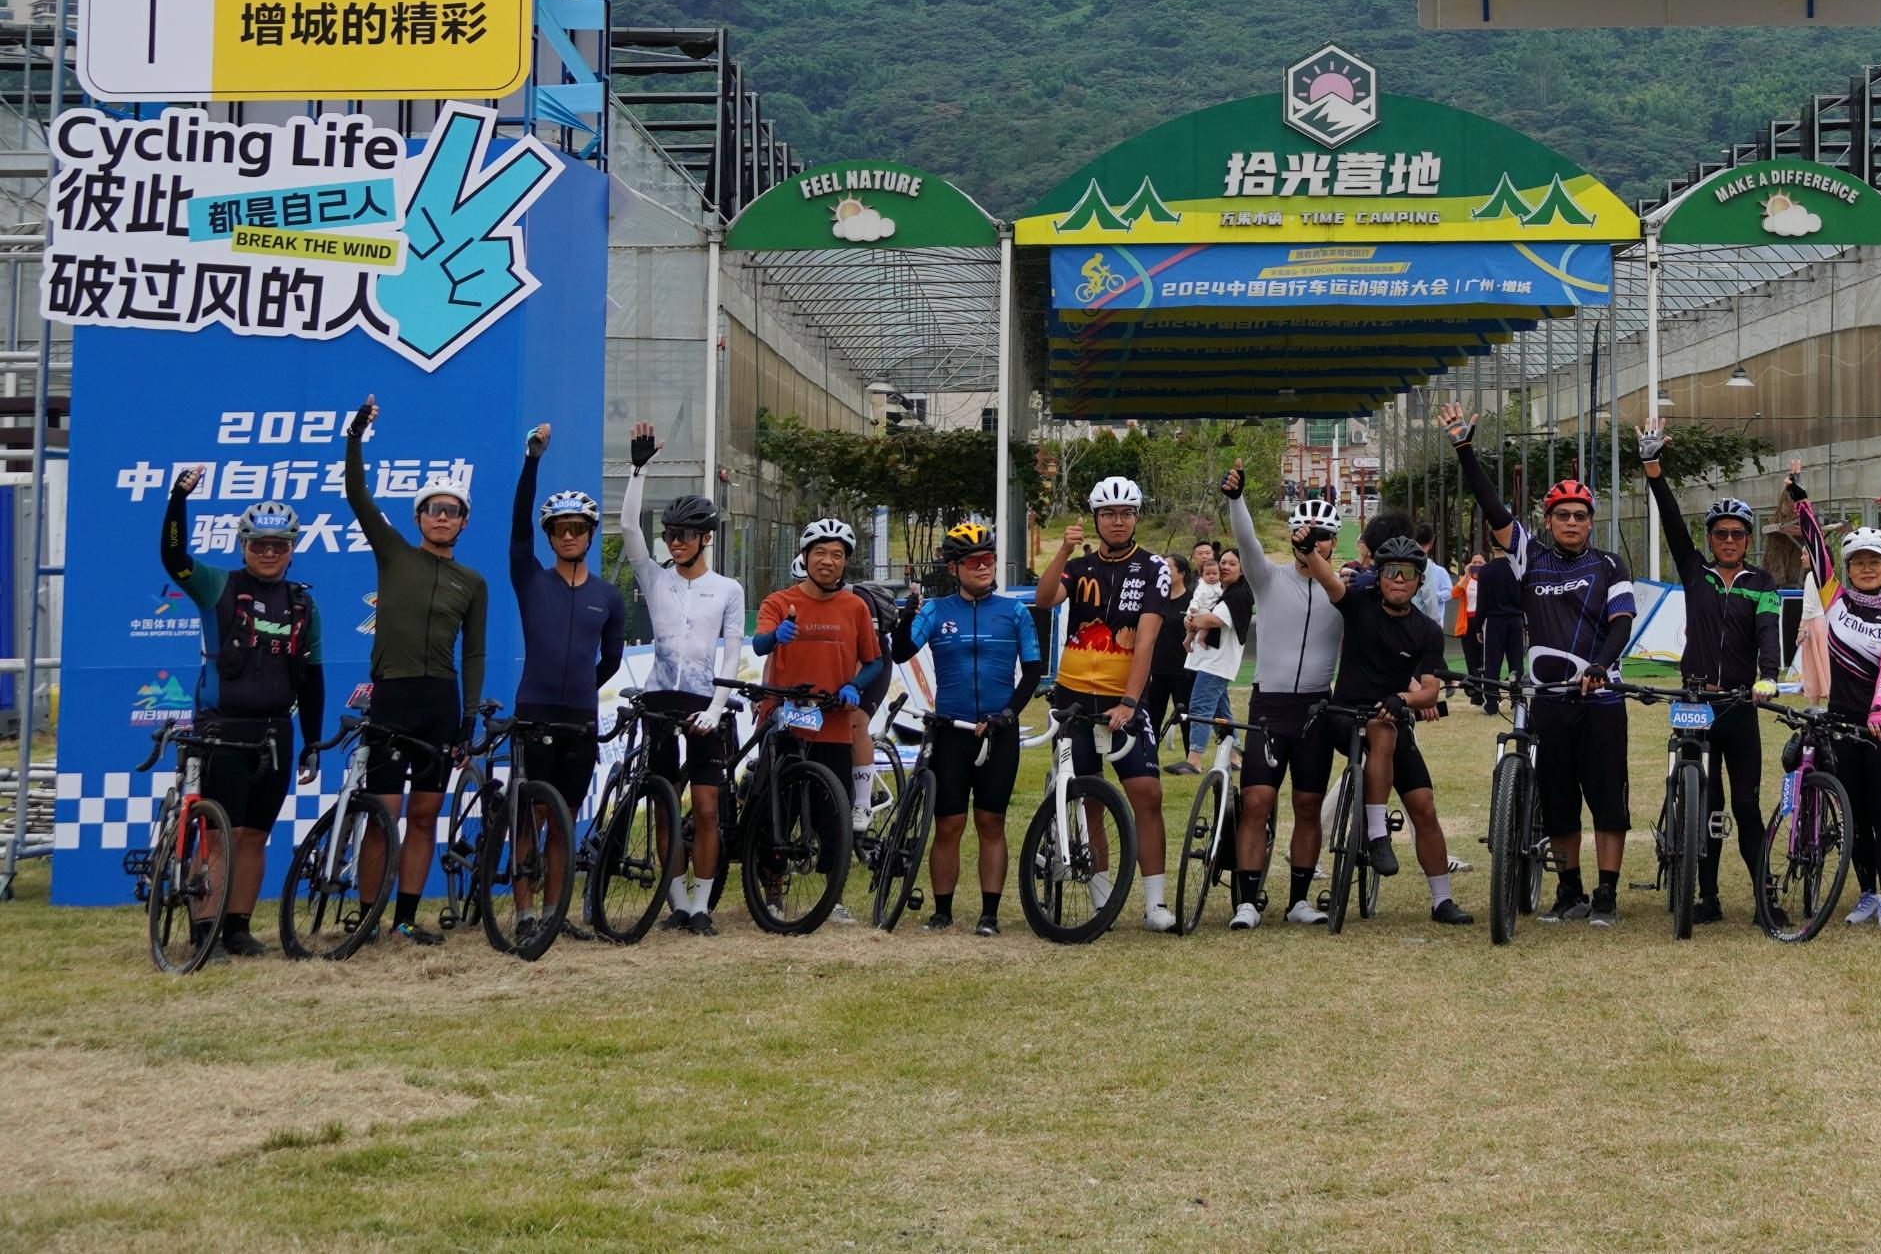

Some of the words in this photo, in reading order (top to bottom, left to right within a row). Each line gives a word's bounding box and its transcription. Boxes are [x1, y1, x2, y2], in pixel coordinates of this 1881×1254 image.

[240, 1, 488, 46] 增城的精彩
[57, 115, 273, 176] Cycling
[292, 121, 399, 171] Life
[799, 172, 843, 200] FEEL
[845, 169, 923, 198] NATURE
[1223, 150, 1442, 197] 拾光营地
[1714, 173, 1754, 204] MAKE
[1758, 171, 1770, 187] A
[1770, 168, 1861, 206] DIFFERENCE
[55, 168, 191, 236] 彼此
[208, 184, 389, 234] 都是自己人
[1300, 210, 1346, 225] TIME
[1355, 210, 1441, 225] CAMPING
[235, 232, 298, 254] BREAK
[303, 237, 338, 256] THE
[342, 241, 393, 261] WIND
[47, 253, 393, 335] 破过风的人
[1161, 278, 1449, 298] 2024中国自行车运动骑游大会
[1673, 712, 1708, 724] A0505
